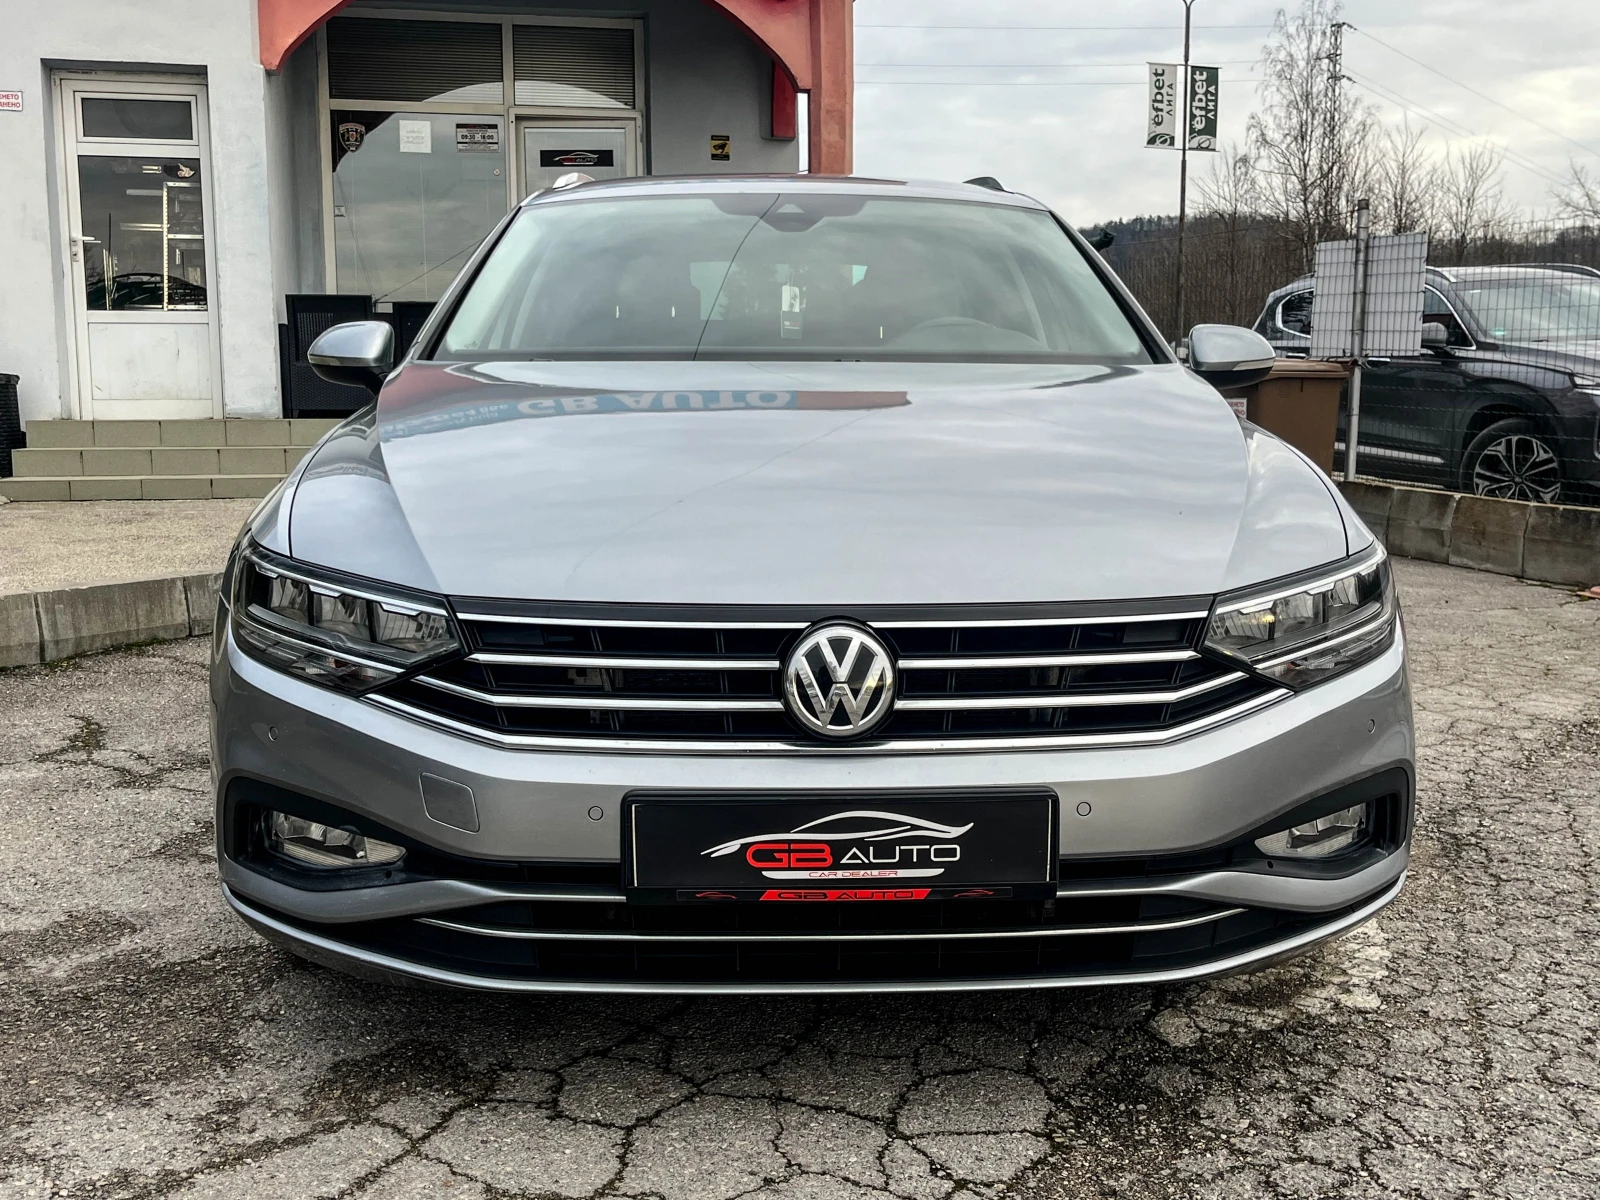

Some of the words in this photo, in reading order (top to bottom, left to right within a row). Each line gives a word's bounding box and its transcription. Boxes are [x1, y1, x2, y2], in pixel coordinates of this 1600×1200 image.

[1152, 68, 1165, 127] efbet
[1192, 71, 1207, 130] efbet
[746, 843, 833, 868] GB
[839, 844, 961, 864] AUTO
[777, 891, 828, 900] GB
[835, 890, 914, 899] AUTO
